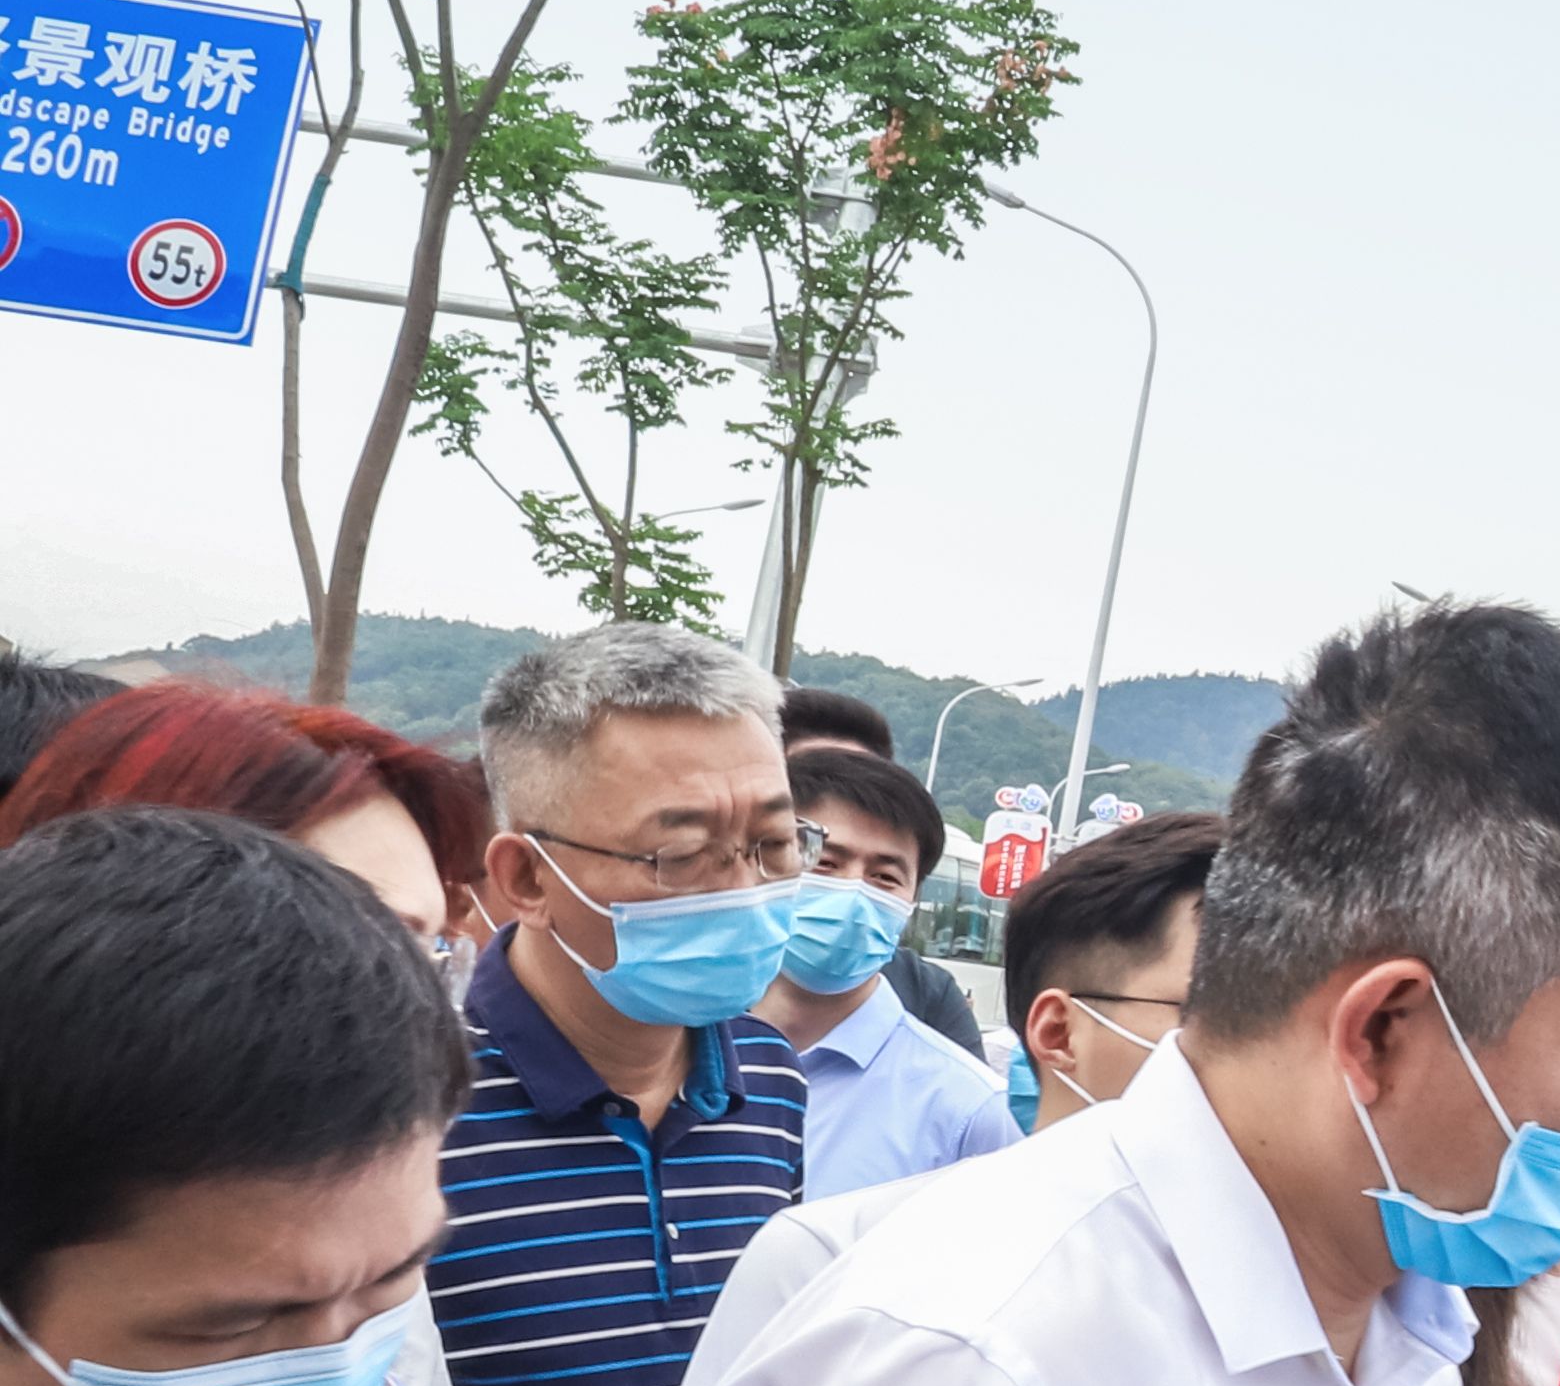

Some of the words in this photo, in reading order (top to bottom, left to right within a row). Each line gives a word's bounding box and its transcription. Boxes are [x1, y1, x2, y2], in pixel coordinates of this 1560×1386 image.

[0, 16, 258, 115] 景观桥
[1, 127, 119, 187] 260m
[127, 107, 231, 155] Bridge
[148, 241, 207, 288] 55t
